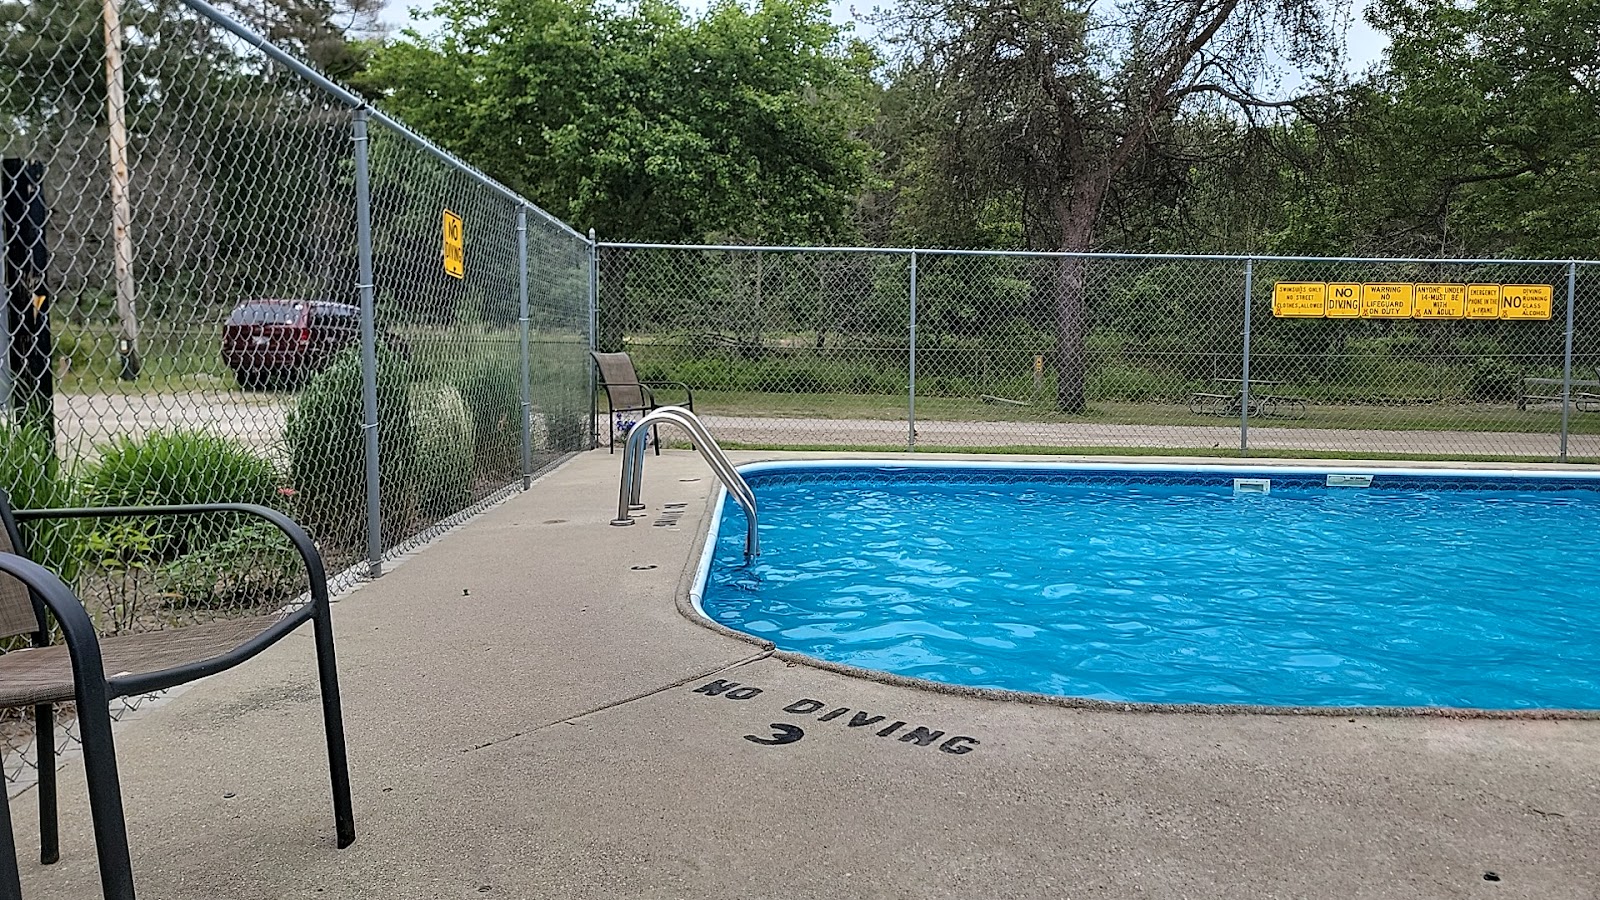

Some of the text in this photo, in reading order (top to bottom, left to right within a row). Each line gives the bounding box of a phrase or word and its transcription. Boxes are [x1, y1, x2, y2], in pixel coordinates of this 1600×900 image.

[449, 221, 459, 241] NO
[445, 242, 462, 263] DIVING
[1335, 288, 1353, 298] NO
[1417, 286, 1441, 294] ANYONE
[1329, 299, 1358, 310] DIVING
[1503, 296, 1522, 308] NO
[692, 679, 981, 755] NO DIVING
[743, 722, 805, 746] 3
